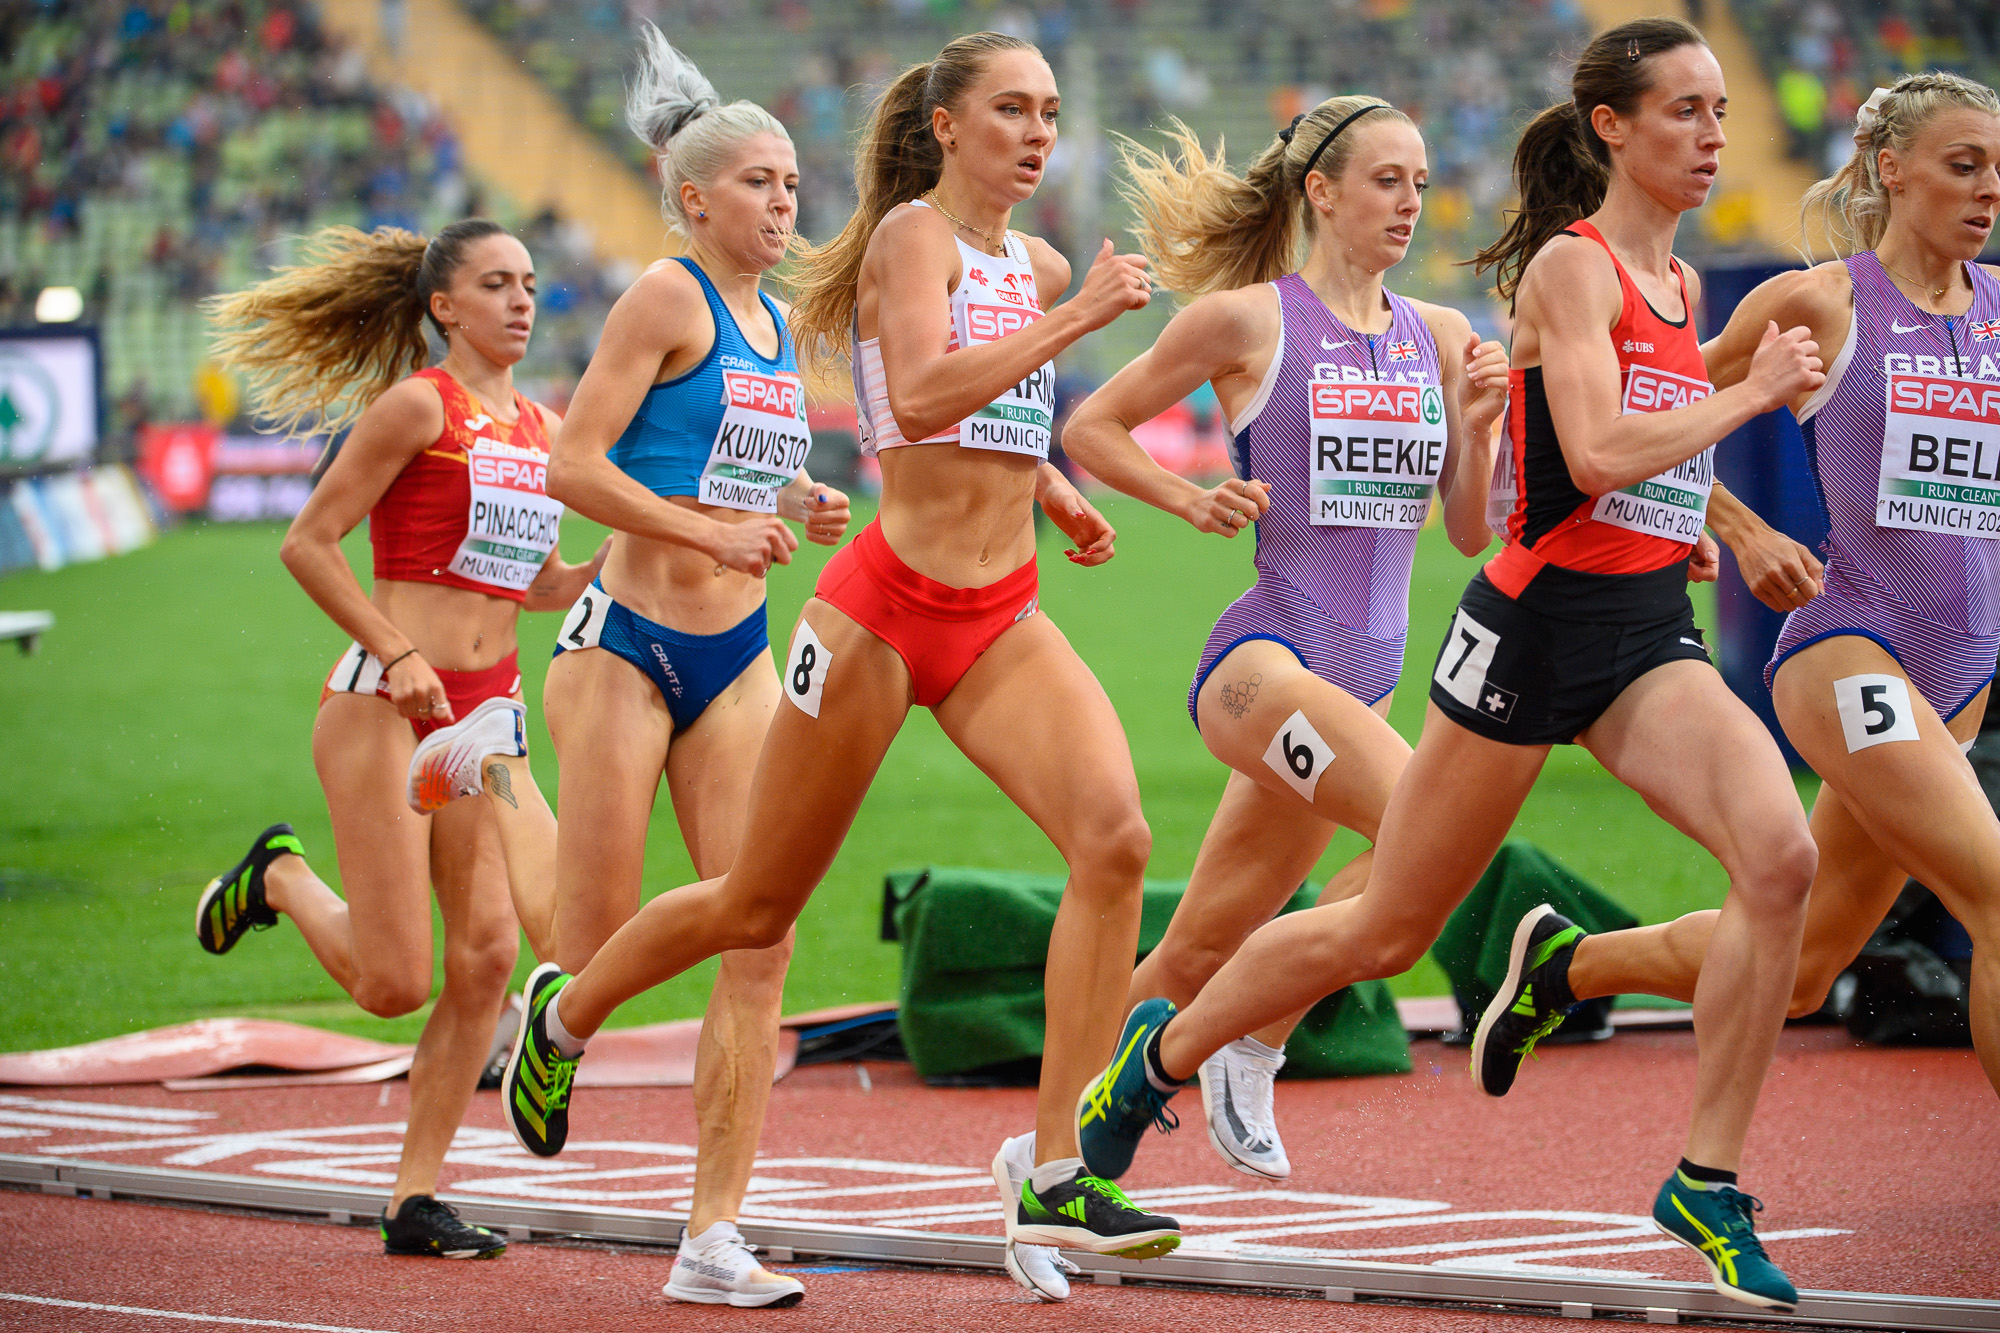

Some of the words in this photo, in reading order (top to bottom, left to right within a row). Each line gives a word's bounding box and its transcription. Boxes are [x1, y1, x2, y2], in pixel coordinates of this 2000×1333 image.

[999, 290, 1022, 304] ORLEN
[1635, 342, 1655, 353] UBS
[720, 355, 753, 371] CRAFT
[1884, 353, 2000, 381] GREA
[730, 378, 795, 414] SPAR
[1316, 388, 1419, 418] SPAR
[1000, 406, 1004, 417] I
[1007, 407, 1031, 421] RUN
[717, 422, 807, 471] KUIVISTO
[971, 422, 1044, 451] MUNICH
[1317, 435, 1442, 476] REEKIE
[475, 458, 546, 493] SPAR
[1348, 481, 1352, 493] I
[1355, 482, 1381, 495] RUN
[1384, 484, 1416, 497] CLEAN
[708, 480, 768, 507] MUNICH
[1638, 483, 1643, 495] I
[1644, 484, 1667, 500] RUN
[1668, 488, 1695, 507] CLEAN
[1920, 483, 1924, 496] I
[1928, 483, 1957, 500] RUN
[1961, 488, 1996, 504] CLEAN
[474, 502, 557, 545] PINACCHIO
[1321, 500, 1394, 522] MUNICH
[1605, 497, 1675, 532] MUNICH
[1888, 500, 1972, 530] MUNICH
[460, 556, 520, 582] MUNICH
[568, 596, 593, 647] 2
[650, 643, 680, 686] CRAFT
[793, 643, 816, 696] 8
[1447, 627, 1480, 682] 7
[1860, 685, 1896, 736] 5
[1282, 729, 1315, 781] 6
